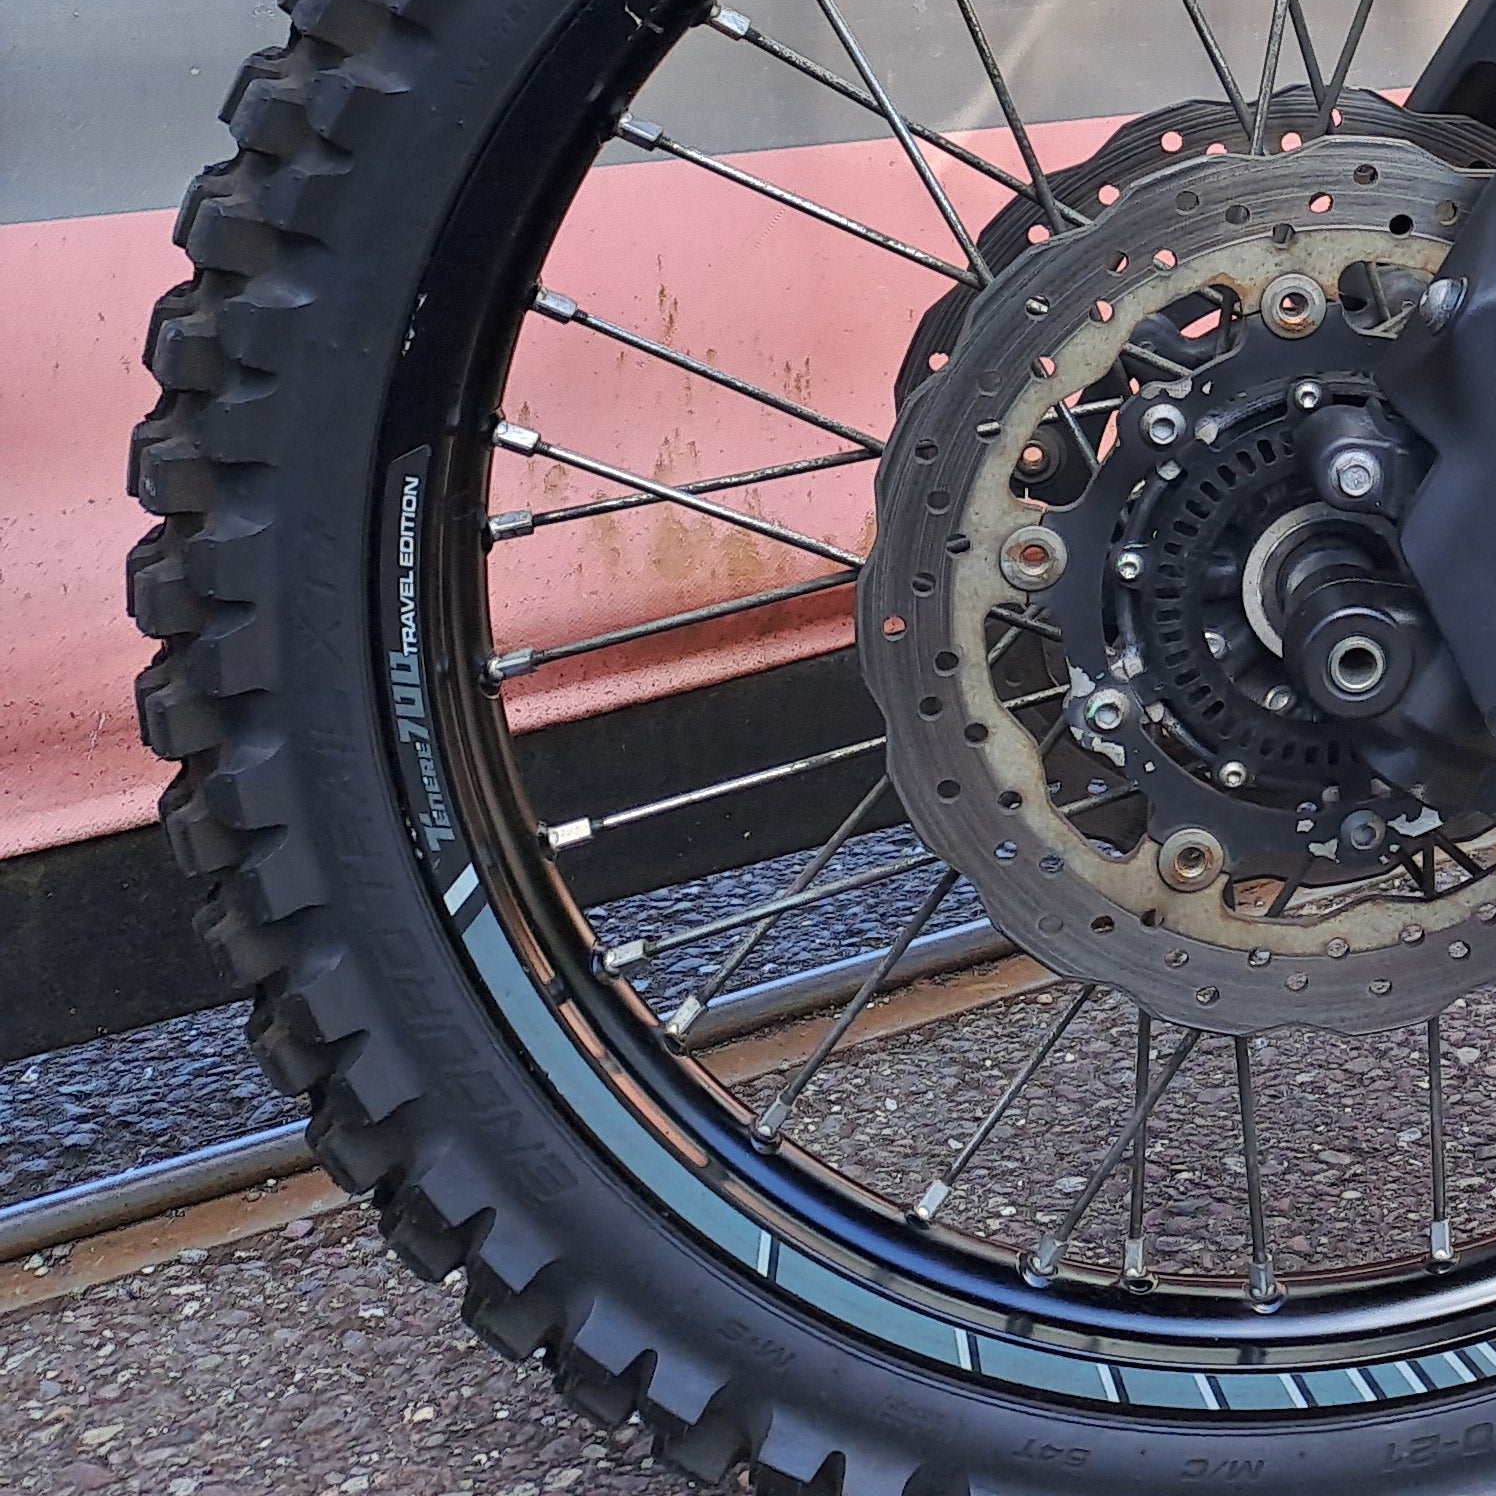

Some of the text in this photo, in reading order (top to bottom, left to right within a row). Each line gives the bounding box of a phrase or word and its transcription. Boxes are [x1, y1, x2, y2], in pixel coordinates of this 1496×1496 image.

[398, 475, 423, 568] EDITION
[400, 569, 422, 657] TRAVEL
[388, 648, 430, 743] 700
[1010, 1436, 1092, 1469] 54T
[1182, 1456, 1267, 1484] M/C
